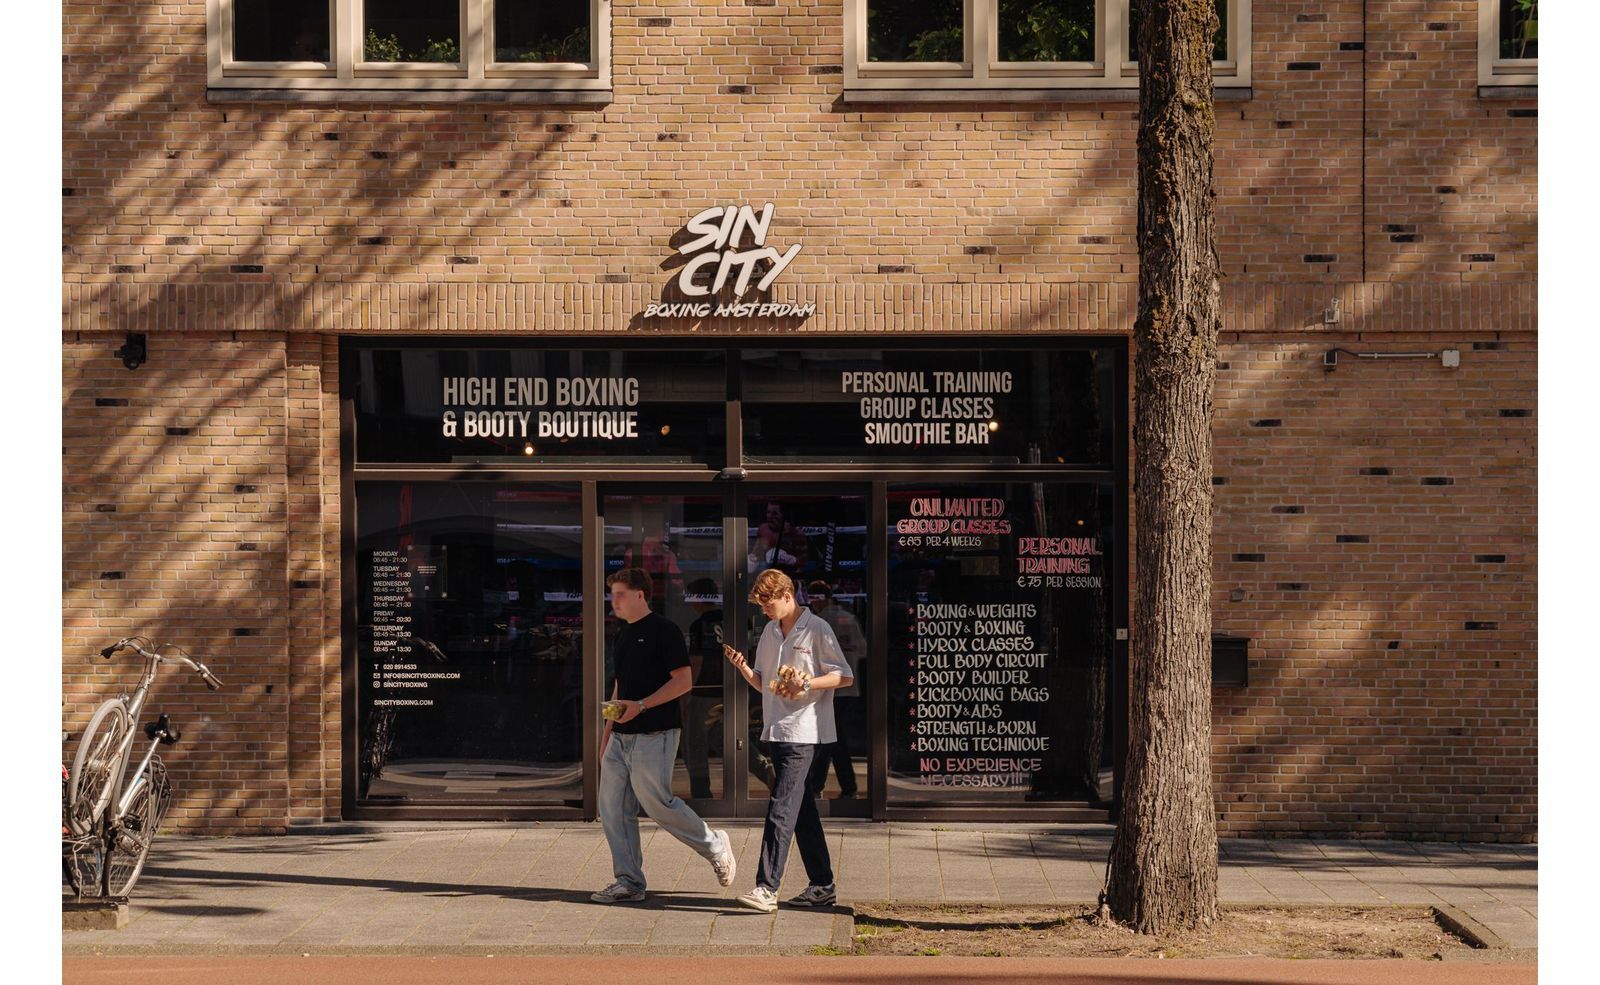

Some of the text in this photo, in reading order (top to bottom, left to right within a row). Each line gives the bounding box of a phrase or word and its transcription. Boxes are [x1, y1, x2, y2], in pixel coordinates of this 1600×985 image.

[678, 202, 775, 255] SIN
[678, 243, 803, 297] CITY
[644, 302, 816, 318] BOXING AMSTERDAM
[842, 372, 1012, 393] PERSONAL TRAINING
[443, 377, 639, 406] HIGH END BOXING
[860, 397, 994, 419] GROUP CLASSES
[442, 411, 638, 439] & BOOTY BOUTIQUE
[864, 422, 989, 444] SMOOTHIE BAR
[910, 498, 1005, 517] UNLIMITED
[896, 519, 1011, 535] GROUP CLASSES
[926, 537, 942, 546] PER
[942, 537, 951, 546] 4
[951, 537, 982, 546] WEEKS
[1018, 538, 1103, 555] PERSONAL
[1016, 558, 1090, 574] TRAINING
[1046, 576, 1062, 588] PER
[1066, 576, 1102, 588] SESSION
[917, 604, 967, 619] BOXING
[976, 604, 1036, 618] WEIGHTS
[917, 621, 1026, 636] BOOTY & BOXING
[918, 636, 1034, 652] HYROX CLASSES
[918, 654, 1048, 669] FULL BODY CIRCUIT
[918, 670, 1031, 685] BOOTY BUILDER
[918, 687, 1050, 702] KICKBOXING BAGS
[918, 704, 1002, 718] BOOTY & ABS
[916, 721, 986, 735] STRENGTH
[997, 721, 1036, 734] BURN
[918, 738, 968, 752] BOXING
[920, 758, 1042, 772] NO EXPERIENCE
